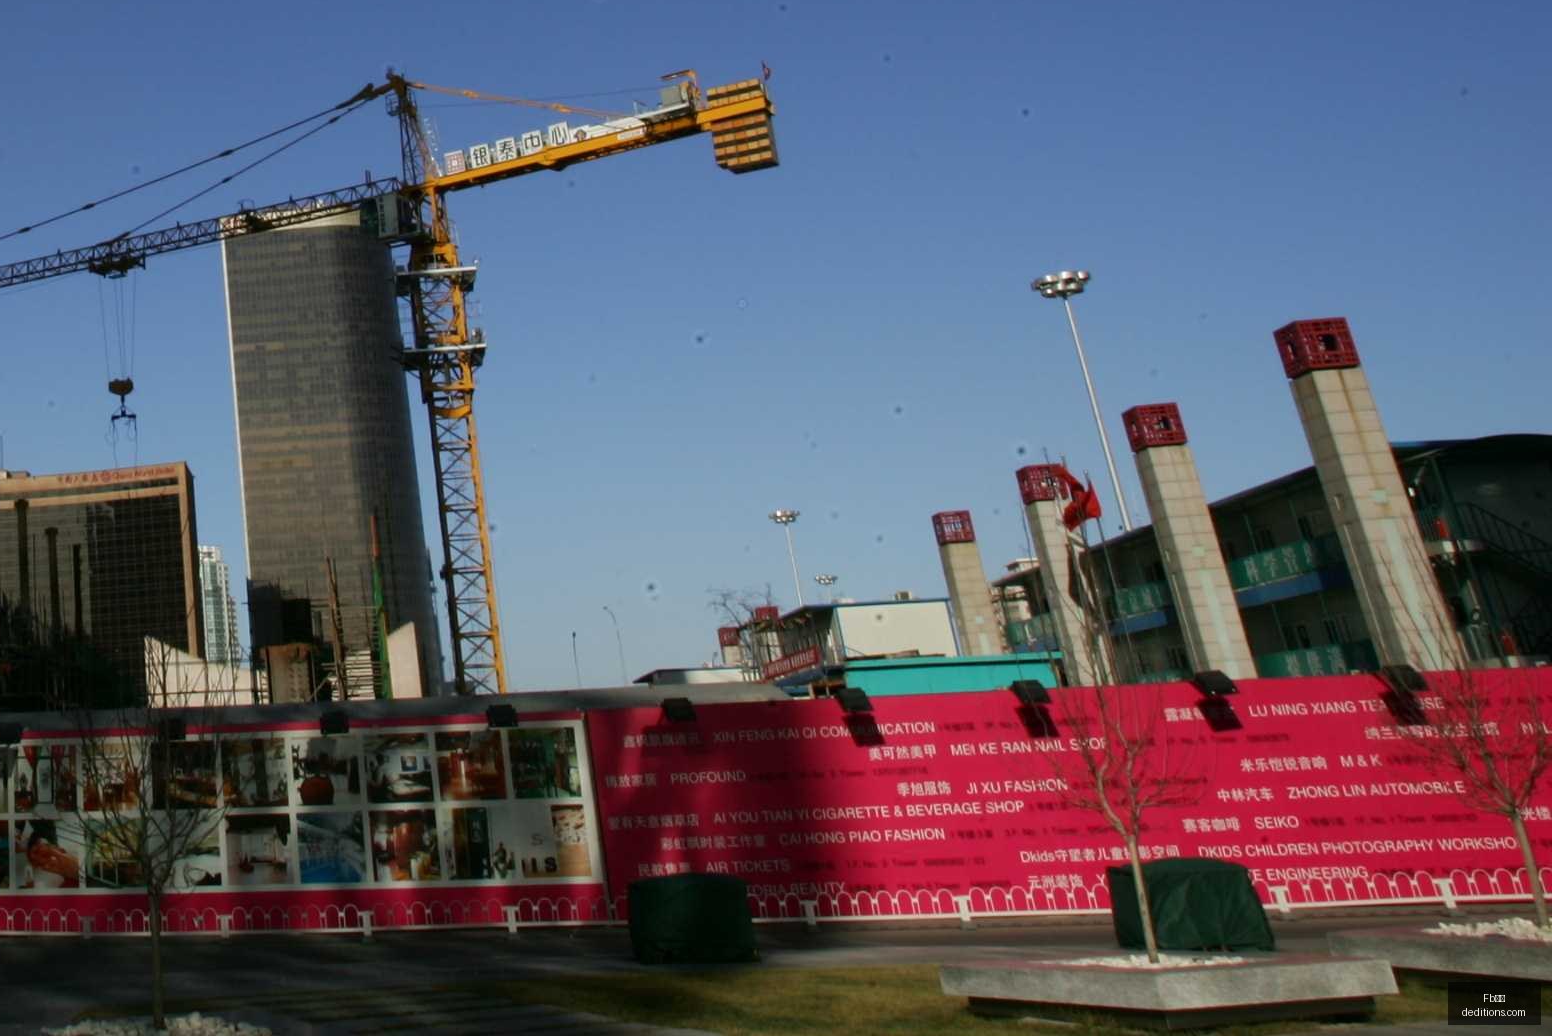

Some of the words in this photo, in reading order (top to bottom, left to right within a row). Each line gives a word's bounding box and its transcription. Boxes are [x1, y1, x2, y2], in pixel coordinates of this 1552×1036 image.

[472, 122, 568, 166] 银泰中心
[1248, 705, 1267, 717] LU
[1271, 704, 1308, 717] NING
[1311, 699, 1356, 715] XIANG
[713, 731, 735, 743] XIN
[739, 729, 775, 742] FENG
[779, 728, 799, 740] KAI
[802, 727, 816, 739] QI
[869, 744, 936, 761] 美可然美甲
[950, 743, 975, 756] MEI
[979, 742, 999, 755] KE
[1001, 740, 1032, 754] RAN
[1035, 738, 1066, 752] NAIL
[671, 770, 746, 785] PROFOUND
[897, 780, 952, 797] 季旭服饰
[966, 782, 979, 796] JI
[982, 782, 1001, 794] XU
[1005, 779, 1068, 793] FASHION
[1217, 787, 1274, 803] 中林汽车
[1287, 786, 1340, 800] ZHONG
[1343, 784, 1366, 797] LIN
[713, 813, 727, 824] AI
[730, 811, 758, 823] YOU
[764, 810, 793, 822] TIAN
[812, 805, 891, 821] CIGARETTE
[893, 805, 904, 817] &
[906, 800, 982, 817] BEVERAGE
[985, 800, 1024, 814] SHOP
[1254, 815, 1299, 829] SEIKO
[779, 833, 801, 845] CAI
[804, 831, 845, 844] HONG
[848, 830, 882, 843] PIAO
[884, 827, 945, 843] FASHION
[1198, 844, 1242, 858] DKIDS
[1245, 842, 1318, 858] CHILDREN
[1322, 838, 1433, 856] PHOTOGRAPHY
[1435, 835, 1520, 852] WORKSHO
[706, 861, 729, 873] AIR
[733, 859, 790, 872] TICKETS
[1266, 866, 1369, 882] ENGINEERING
